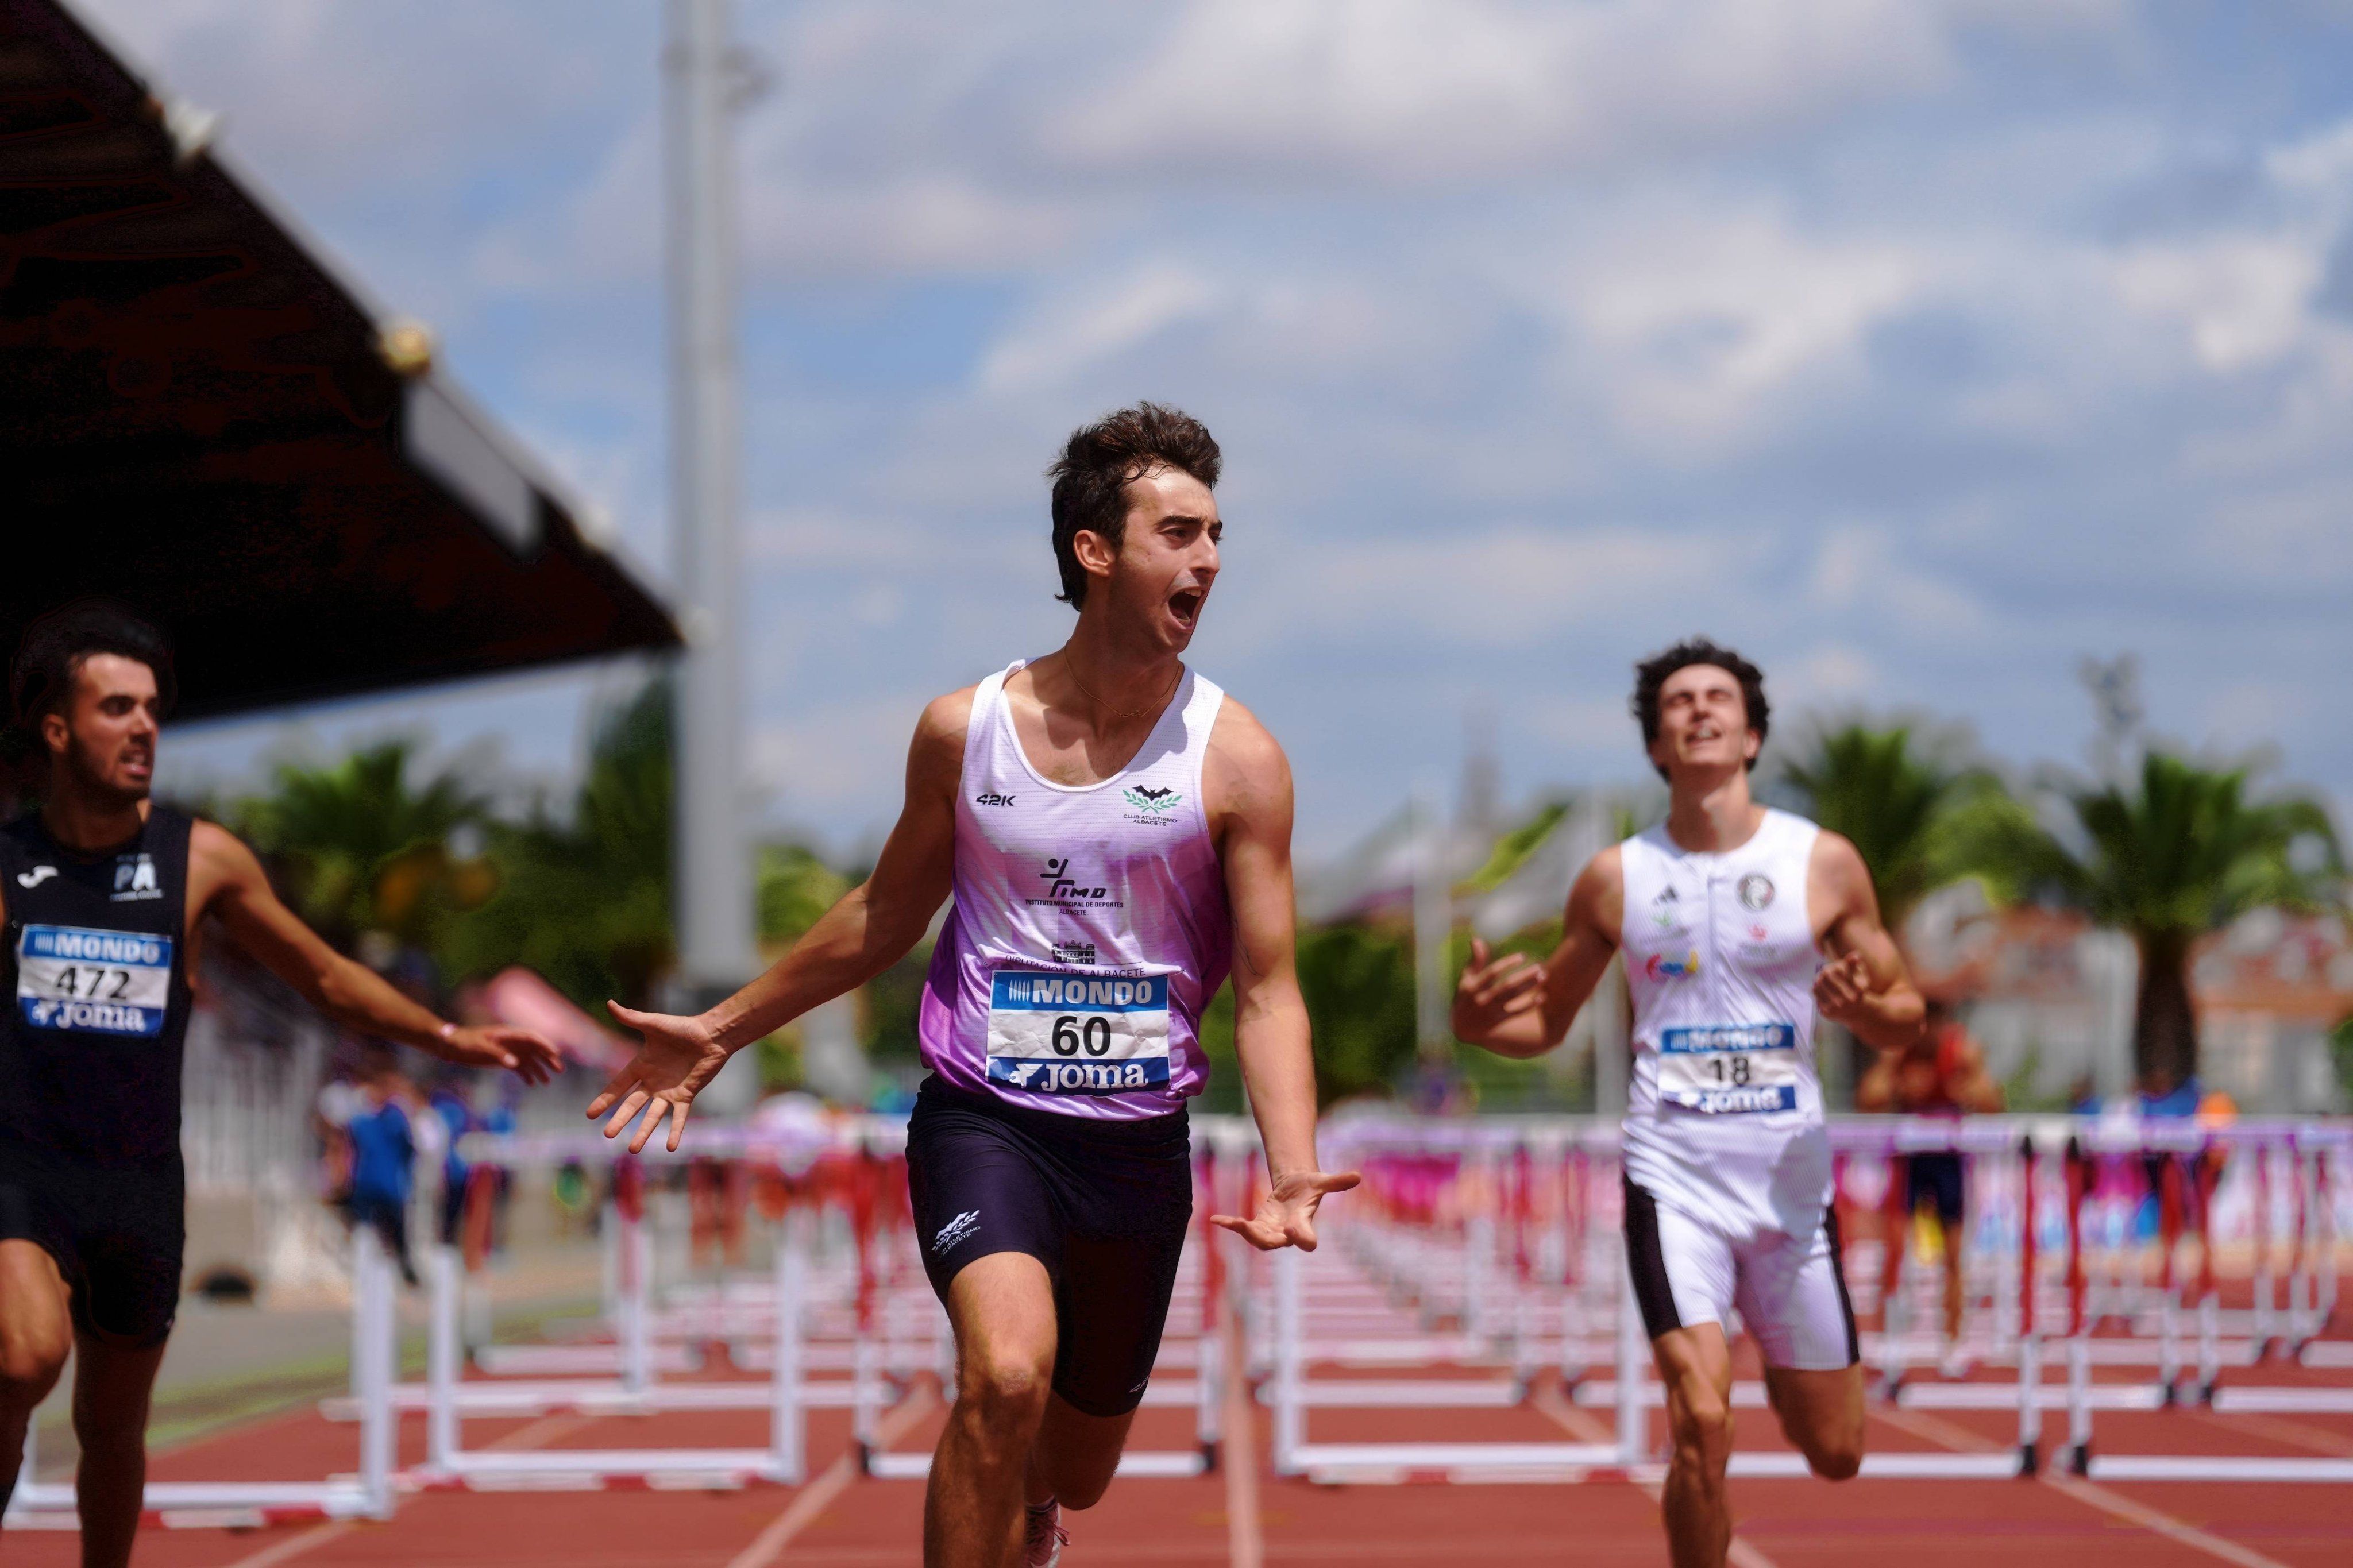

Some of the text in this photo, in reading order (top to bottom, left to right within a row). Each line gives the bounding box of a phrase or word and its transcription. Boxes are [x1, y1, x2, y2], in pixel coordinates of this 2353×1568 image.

[976, 794, 1016, 806] 42K
[54, 933, 160, 964] MONDO
[56, 967, 130, 1000] 472
[1032, 979, 1152, 1005] MONDO
[1052, 1015, 1111, 1056] 60
[1688, 1026, 1783, 1052] MONDO
[1709, 1057, 1750, 1087] 18
